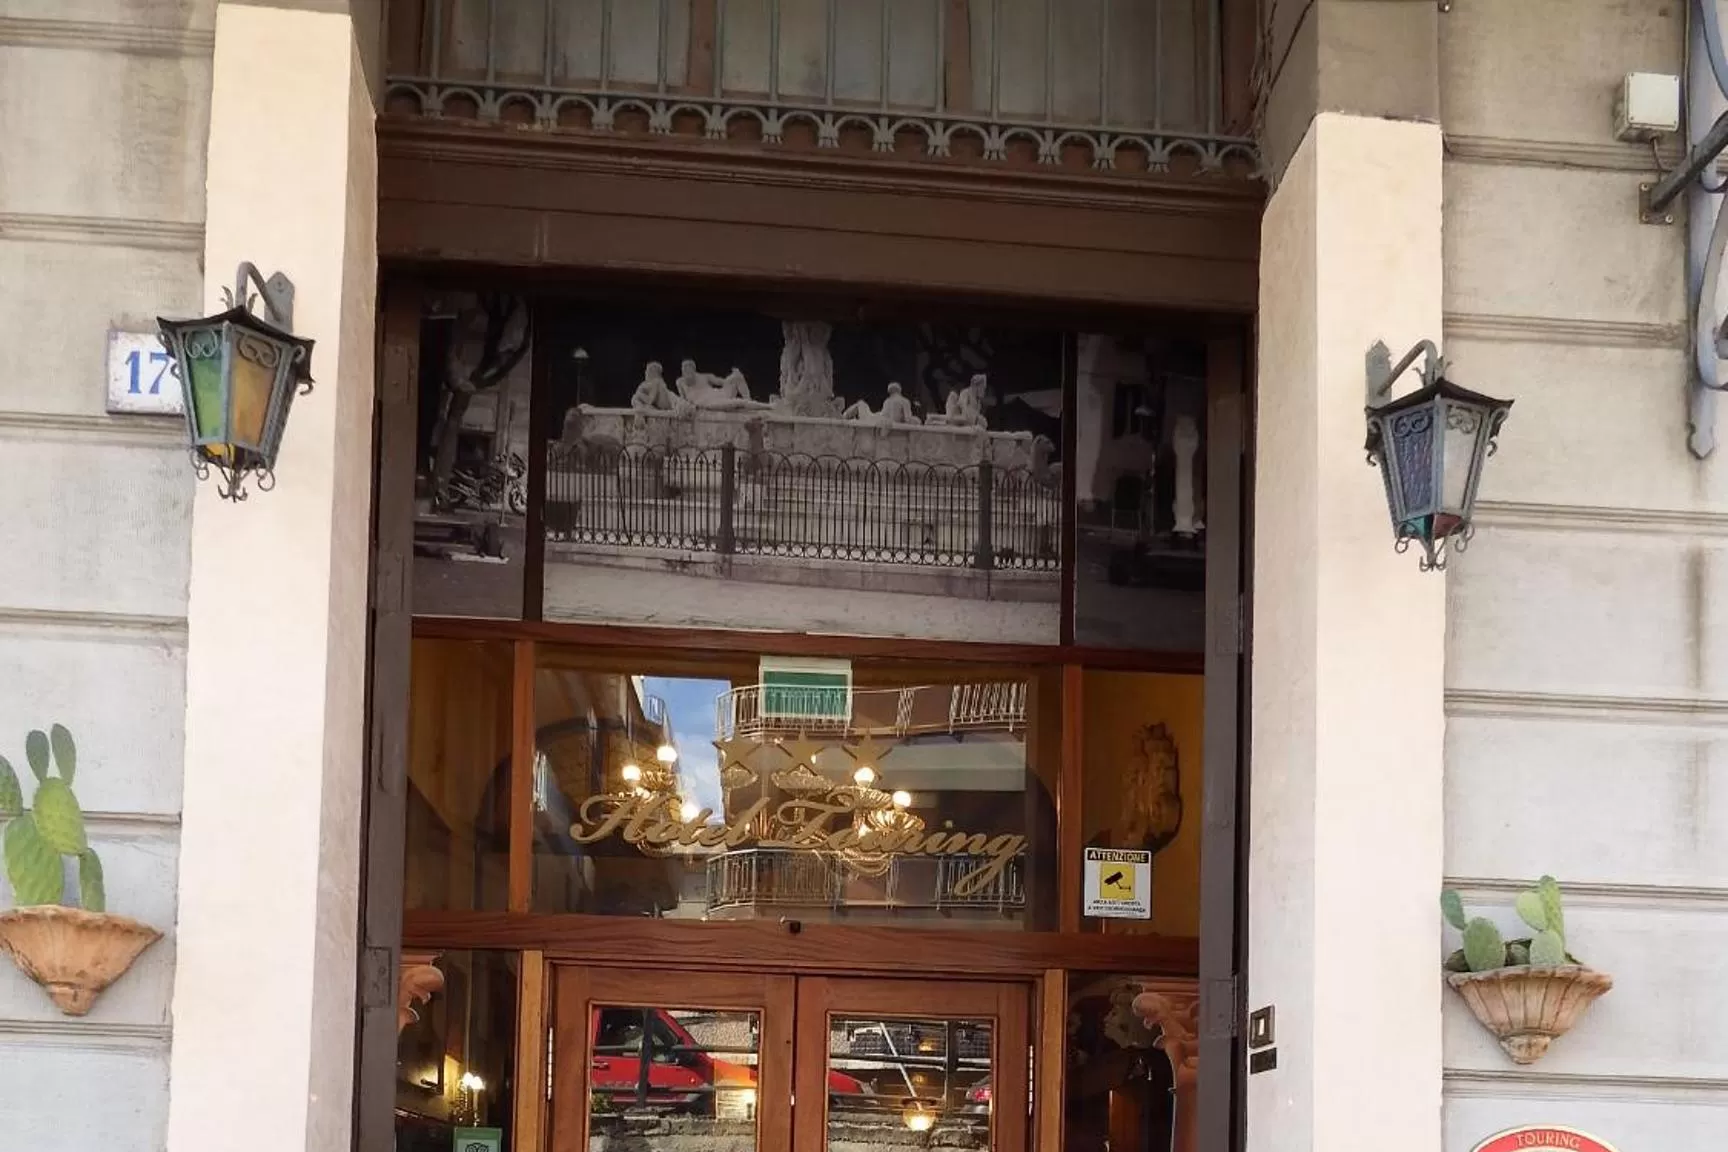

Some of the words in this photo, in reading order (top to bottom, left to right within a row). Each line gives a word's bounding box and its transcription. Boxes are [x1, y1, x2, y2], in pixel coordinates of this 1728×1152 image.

[124, 350, 170, 395] 17
[569, 793, 771, 847] Hotel
[776, 786, 1028, 897] Touring
[1089, 850, 1147, 863] ATTENZIONE
[1516, 1131, 1581, 1149] TOURING
